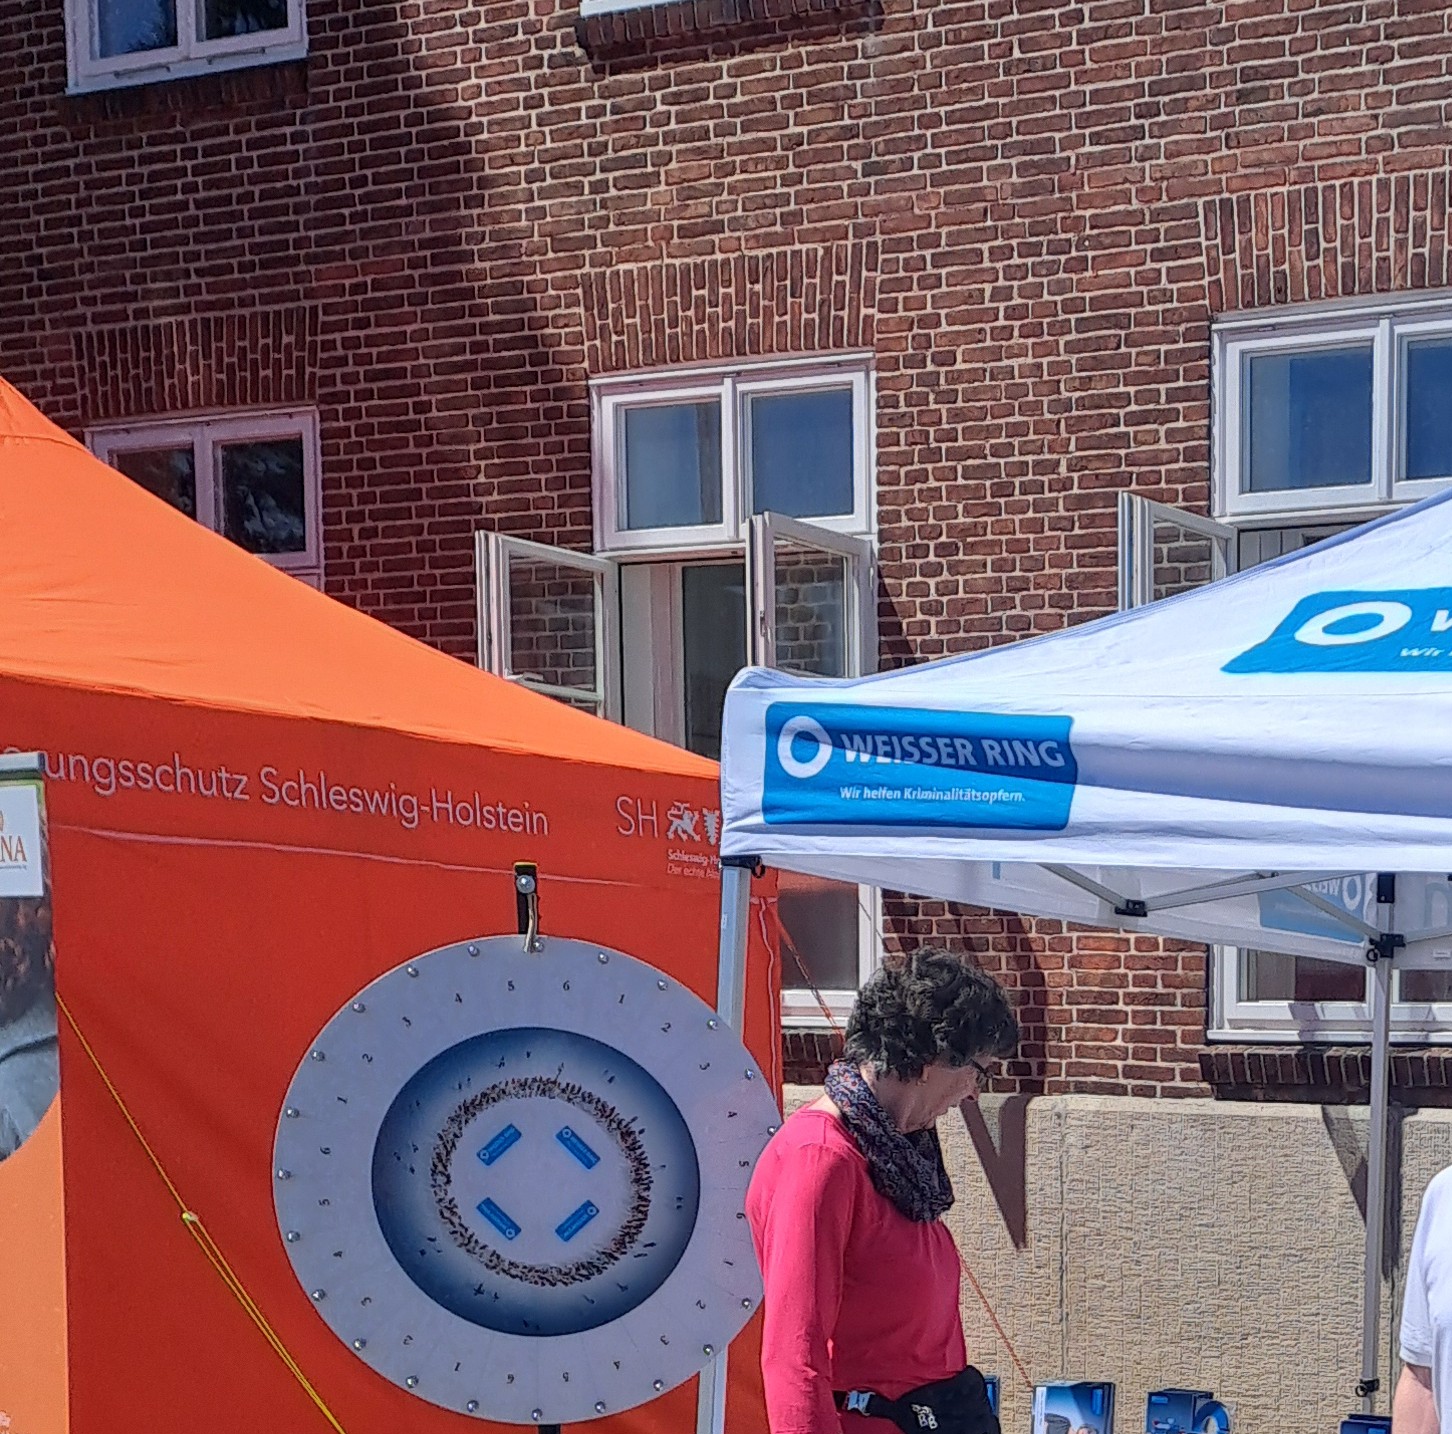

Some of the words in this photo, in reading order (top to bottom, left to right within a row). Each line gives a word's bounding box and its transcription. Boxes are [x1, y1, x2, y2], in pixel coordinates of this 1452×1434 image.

[1400, 647, 1444, 659] Wir
[840, 733, 978, 766] WEISSER
[981, 738, 1066, 768] RING
[4, 747, 250, 801] ungsschutz
[259, 766, 549, 836] Schleswig-Holstein
[840, 787, 860, 799] Wir
[863, 787, 901, 799] helfen
[904, 787, 1026, 805] Kriminalitätsopfern.
[616, 795, 659, 838] SH
